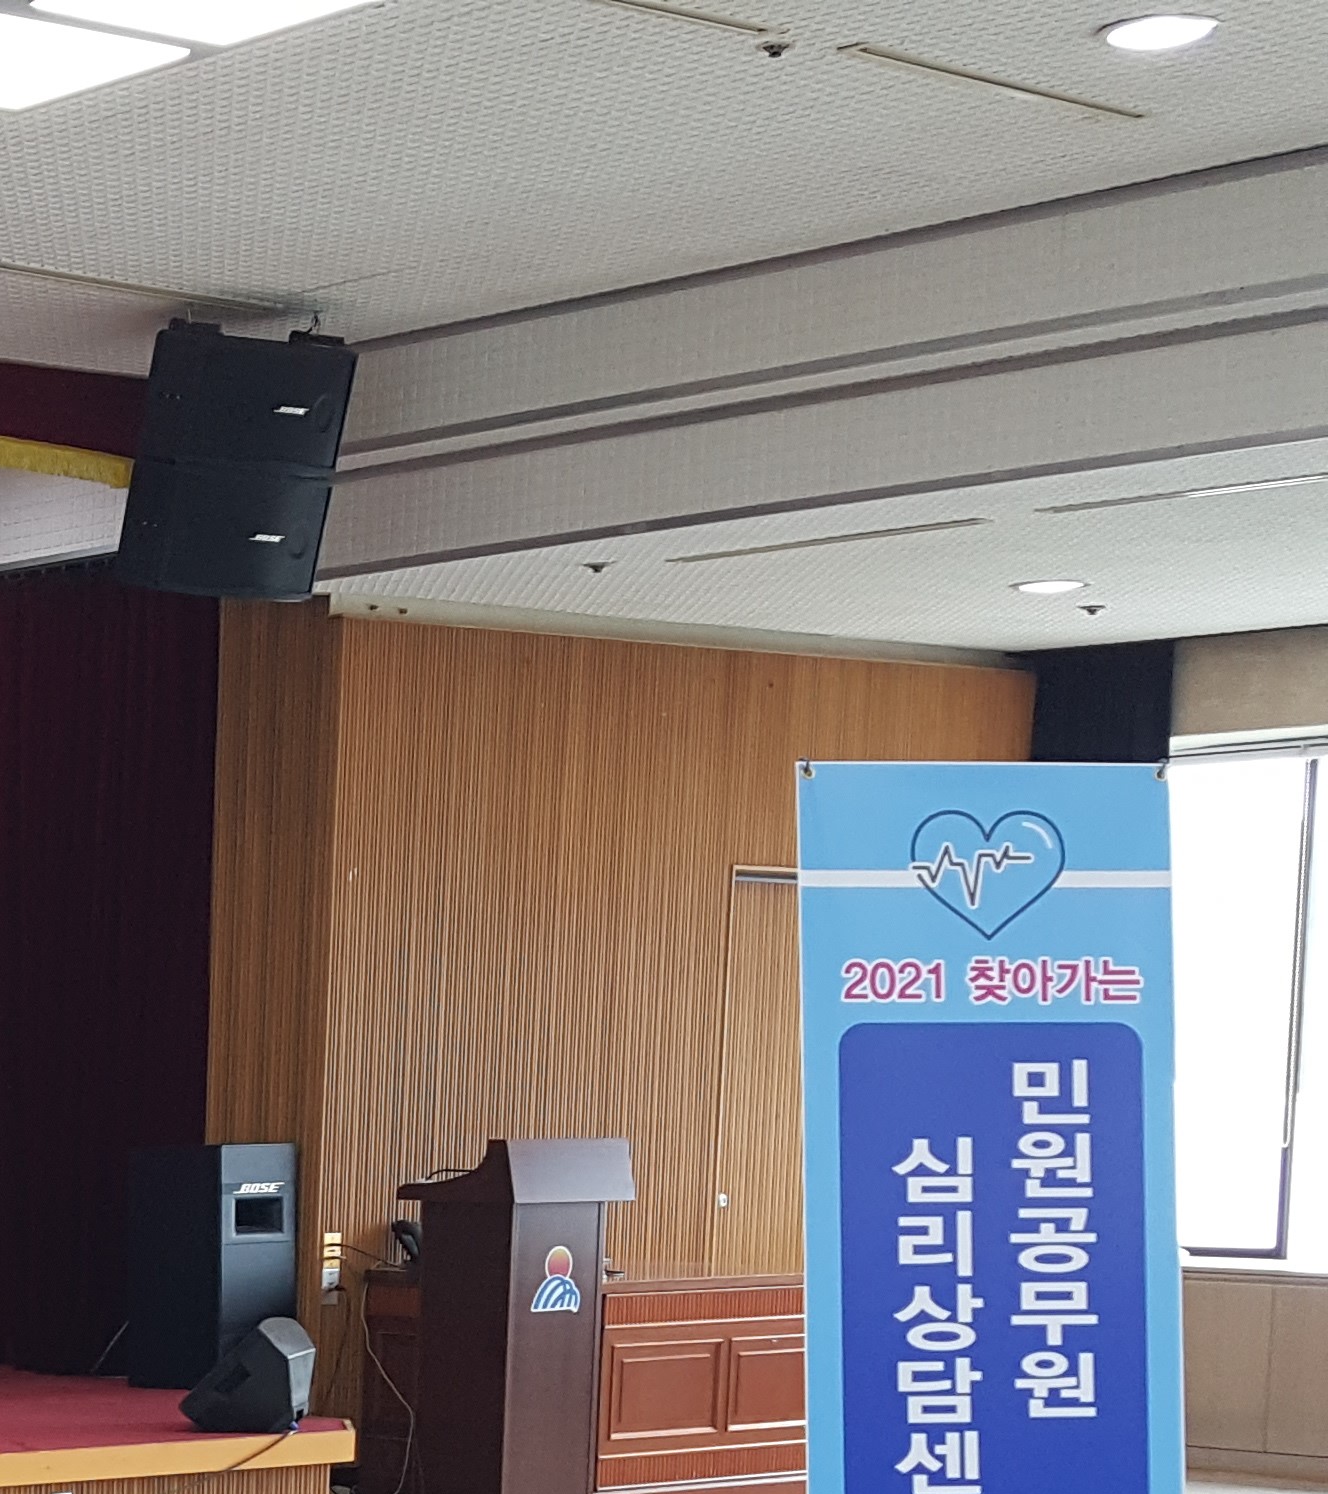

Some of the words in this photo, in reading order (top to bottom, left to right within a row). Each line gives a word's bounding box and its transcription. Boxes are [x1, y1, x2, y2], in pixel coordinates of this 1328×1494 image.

[843, 960, 944, 1001] 2021
[968, 958, 1142, 1003] 찾아가는
[233, 1182, 285, 1195] BOSE
[1009, 1058, 1099, 1419] 민원공무원
